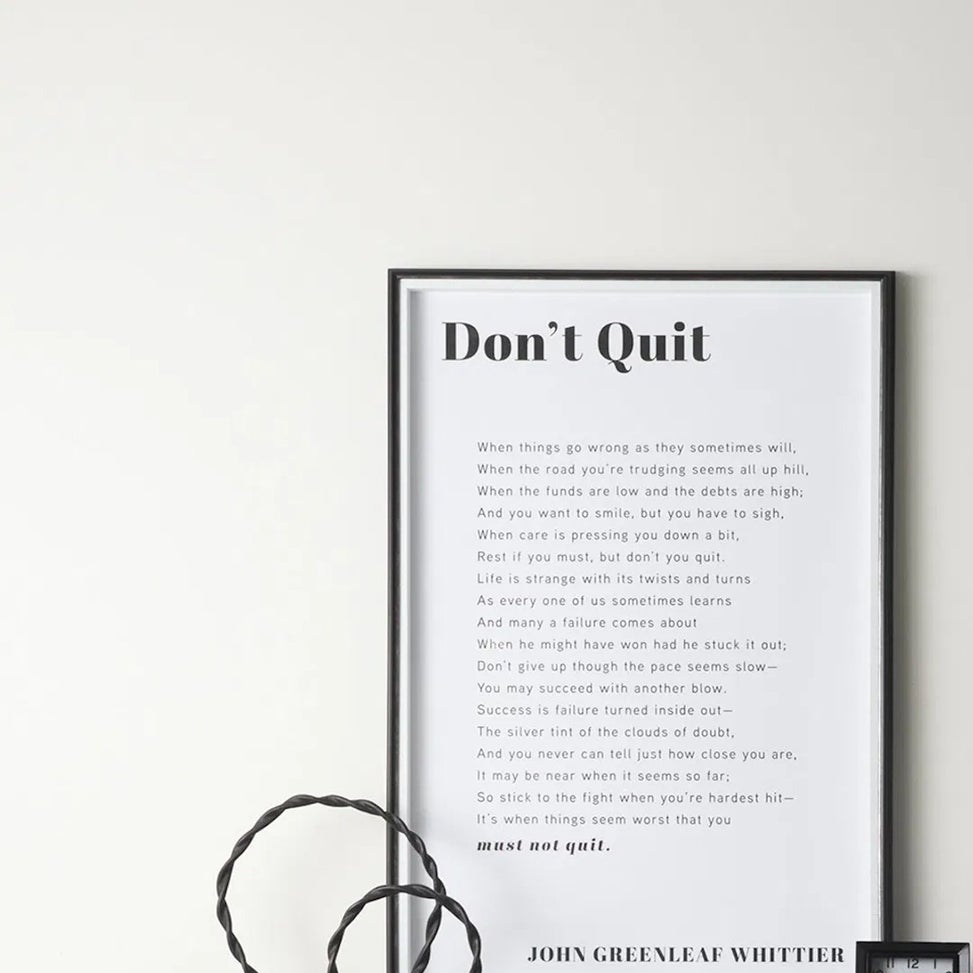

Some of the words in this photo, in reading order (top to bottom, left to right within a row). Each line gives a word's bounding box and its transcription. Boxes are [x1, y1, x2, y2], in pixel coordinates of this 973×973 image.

[441, 320, 584, 362] Don’t
[596, 320, 712, 375] Quit
[477, 441, 514, 453] When
[519, 441, 561, 456] things
[566, 444, 582, 456] go
[587, 444, 630, 456] wrong
[635, 444, 650, 453] as
[655, 441, 685, 456] they
[689, 441, 763, 454] sometimes
[767, 441, 797, 455] will,
[477, 463, 513, 475] When
[519, 463, 540, 475] the
[545, 464, 576, 476] road
[581, 463, 624, 478] you're
[629, 463, 686, 478] trudging
[691, 466, 735, 475] seems
[739, 463, 757, 476] all
[762, 466, 778, 478] up
[783, 463, 809, 476] hill,
[476, 485, 513, 497] When
[519, 485, 540, 497] the
[546, 485, 583, 497] funds
[588, 487, 610, 497] are
[616, 485, 639, 497] low
[644, 485, 669, 497] and
[674, 485, 696, 497] the
[700, 485, 738, 497] debts
[743, 488, 765, 497] are
[770, 485, 804, 500] high;
[476, 507, 503, 519] And
[508, 509, 532, 521] you
[537, 508, 570, 519] want
[576, 508, 589, 519] to
[594, 507, 635, 520] smile,
[640, 507, 662, 519] but
[667, 509, 691, 522] you
[697, 507, 728, 519] have
[733, 508, 747, 519] to
[752, 507, 785, 522] sigh,
[477, 550, 506, 563] Rest
[512, 551, 522, 562] if
[527, 553, 551, 565] you
[556, 552, 594, 564] must,
[599, 551, 621, 563] but
[626, 550, 660, 563] don't
[665, 553, 689, 566] you
[694, 551, 725, 565] quit.
[477, 572, 503, 585] Life
[508, 573, 520, 584] is
[525, 574, 576, 587] strange
[581, 572, 611, 584] with
[616, 572, 634, 585] its
[639, 572, 681, 585] twists
[685, 573, 710, 585] and
[715, 574, 751, 585] turns
[476, 594, 494, 606] As
[499, 597, 537, 609] every
[542, 597, 566, 607] one
[571, 594, 585, 607] of
[590, 597, 606, 607] us
[611, 594, 684, 607] sometimes
[689, 595, 732, 607] learns
[476, 616, 503, 628] And
[508, 619, 544, 631] many
[549, 619, 557, 629] a
[562, 616, 607, 629] failure
[611, 619, 655, 629] comes
[660, 617, 697, 629] about
[476, 638, 513, 650] When
[519, 638, 535, 650] he
[540, 638, 578, 653] might
[583, 638, 615, 650] have
[620, 641, 648, 650] won
[653, 638, 677, 651] had
[682, 638, 699, 650] he
[704, 639, 740, 651] stuck
[746, 638, 755, 650] it
[760, 640, 787, 652] out;
[477, 659, 512, 672] Don't
[518, 660, 545, 675] give
[550, 662, 567, 674] up
[572, 660, 618, 675] though
[623, 660, 645, 672] the
[650, 663, 682, 675] pace
[687, 663, 730, 673] seems
[477, 682, 501, 694] You
[506, 684, 534, 697] may
[538, 682, 593, 694] succeed
[599, 682, 628, 694] with
[633, 682, 686, 694] another
[691, 682, 727, 694] blow.
[476, 703, 532, 716] Success
[538, 703, 550, 716] is
[555, 704, 599, 716] failure
[604, 704, 648, 716] turned
[654, 704, 695, 716] inside
[476, 725, 502, 738] The
[507, 726, 545, 738] silver
[550, 725, 573, 737] tint
[578, 726, 592, 738] of
[597, 726, 619, 738] the
[624, 726, 669, 738] clouds
[673, 726, 688, 738] of
[692, 726, 735, 739] doubt,
[476, 747, 502, 759] And
[508, 750, 532, 762] you
[538, 750, 575, 760] never
[580, 750, 605, 760] can
[610, 748, 632, 760] tell
[636, 747, 662, 762] just
[668, 748, 696, 760] how
[700, 748, 737, 760] close
[741, 750, 766, 763] you
[771, 750, 797, 761] are,
[476, 791, 494, 803] So
[499, 791, 532, 803] stick
[537, 793, 551, 803] to
[555, 791, 577, 804] the
[582, 791, 613, 806] fight
[619, 792, 655, 804] when
[660, 791, 703, 807] you're
[708, 792, 759, 804] hardest
[476, 812, 498, 825] It's
[503, 813, 539, 825] when
[544, 813, 586, 828] things
[591, 815, 627, 825] seem
[632, 815, 670, 826] worst
[675, 813, 702, 826] that
[707, 816, 731, 829] you
[476, 839, 523, 852] must
[529, 839, 559, 852] not
[565, 837, 611, 856] quit.
[527, 946, 586, 963] JOHN
[592, 946, 724, 963] GREENLEAF
[730, 946, 845, 964] WHITTIER
[908, 959, 919, 969] 12
